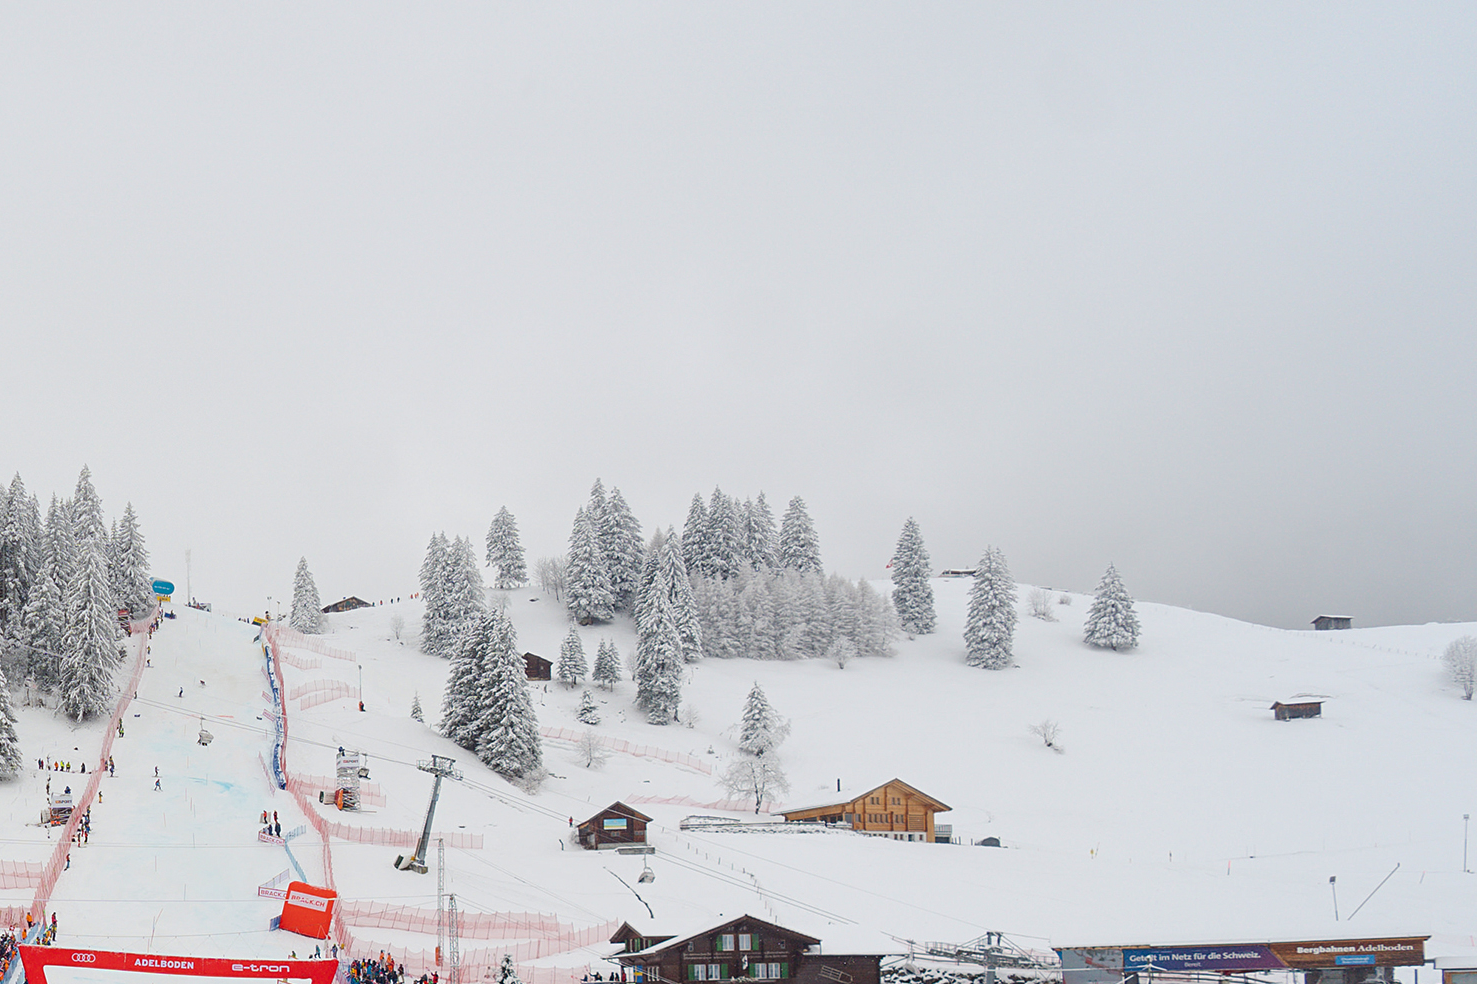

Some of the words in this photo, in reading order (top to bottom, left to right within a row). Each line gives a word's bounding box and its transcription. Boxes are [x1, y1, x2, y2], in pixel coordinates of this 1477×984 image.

[290, 894, 325, 908] BRACK.CH
[1296, 945, 1356, 954] Bergbahnen
[1356, 943, 1414, 952] Adelboden
[1158, 954, 1170, 962] im
[1172, 953, 1192, 961] Netz
[1194, 952, 1208, 960] für
[1208, 952, 1222, 960] die
[1222, 950, 1261, 960] Schweiz.
[134, 958, 194, 970] ADELBODEN
[231, 964, 290, 972] e-tron
